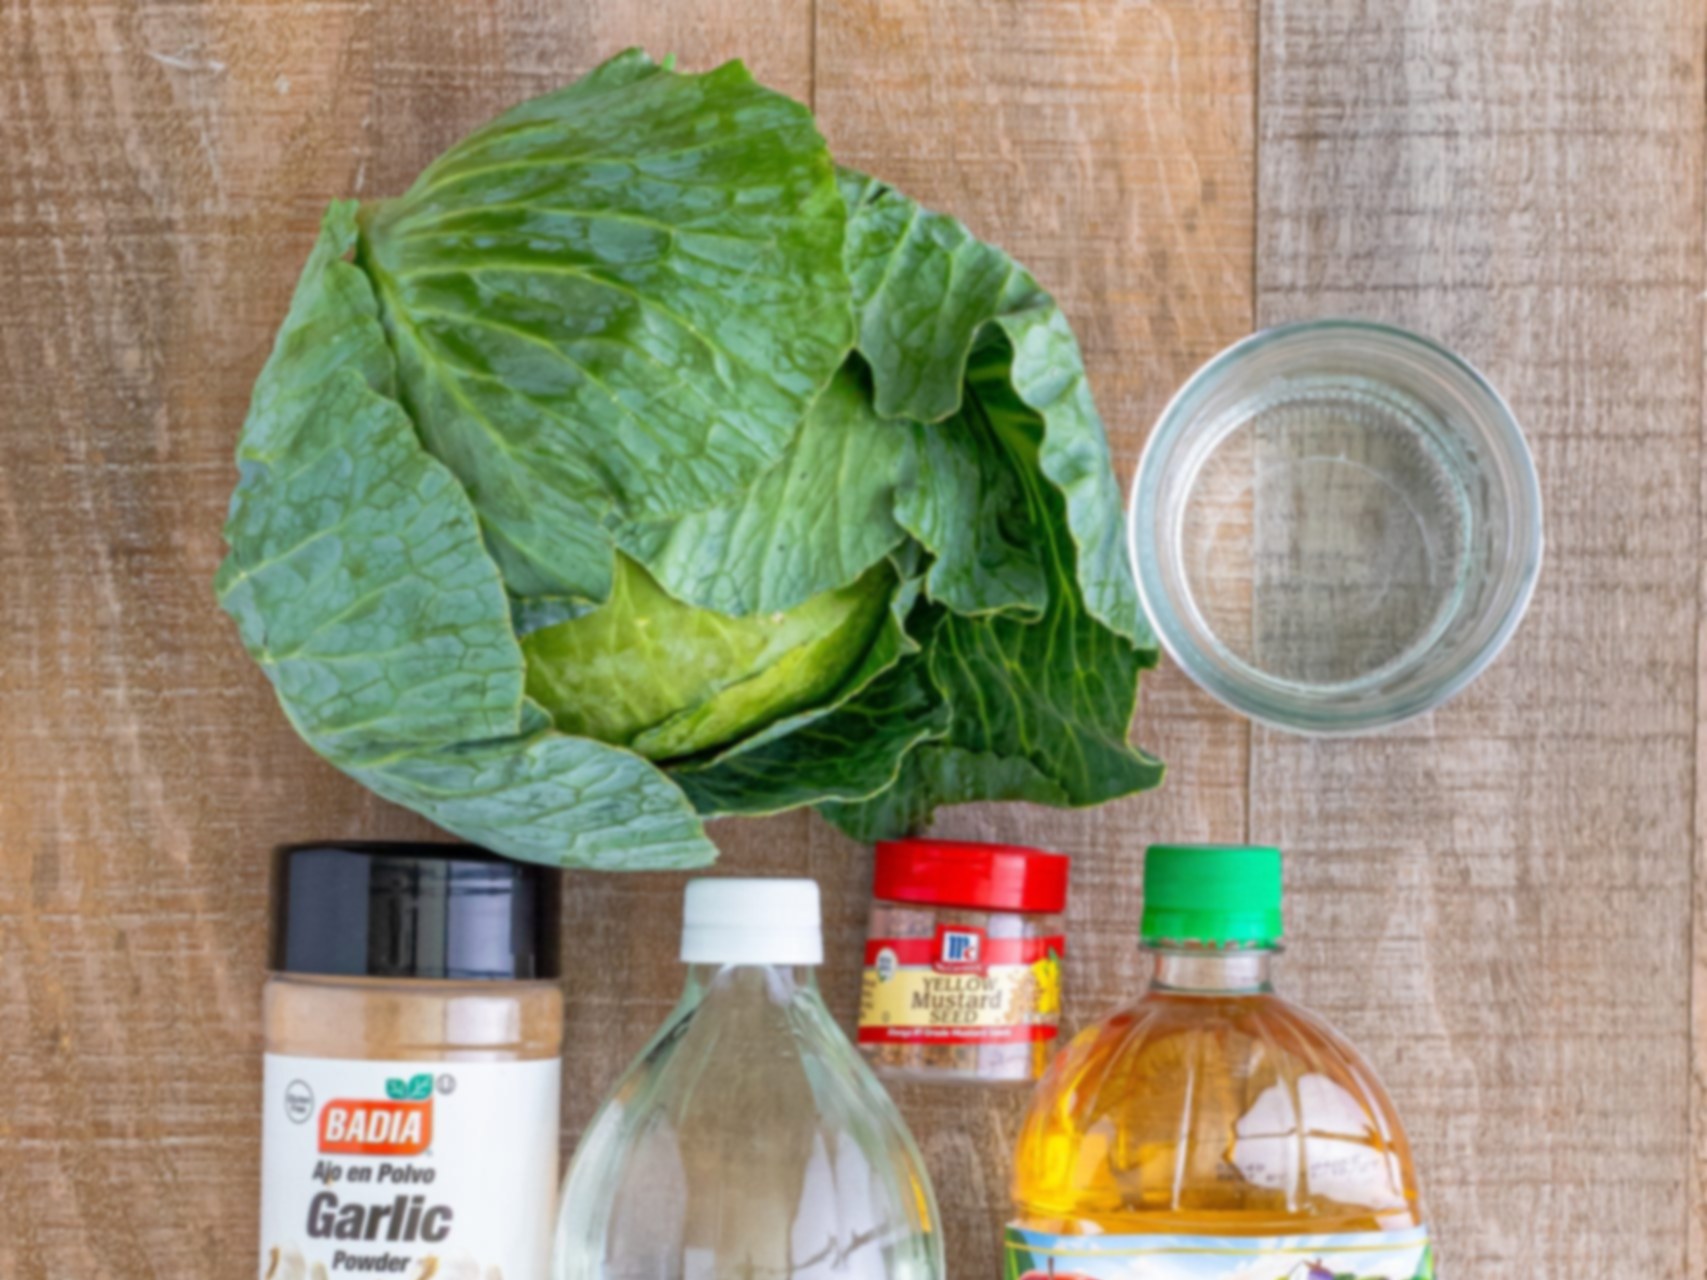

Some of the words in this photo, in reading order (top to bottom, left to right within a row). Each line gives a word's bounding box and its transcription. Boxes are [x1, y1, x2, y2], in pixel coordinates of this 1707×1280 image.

[922, 976, 997, 993] YELLOW
[911, 989, 1003, 1010] Mustard
[929, 1010, 979, 1026] SEED
[325, 1107, 423, 1144] BADIA
[312, 1160, 342, 1185] Ajo
[346, 1165, 372, 1183] en
[377, 1163, 436, 1185] Polvo
[306, 1190, 454, 1243] Garlic
[331, 1250, 411, 1274] Powder
